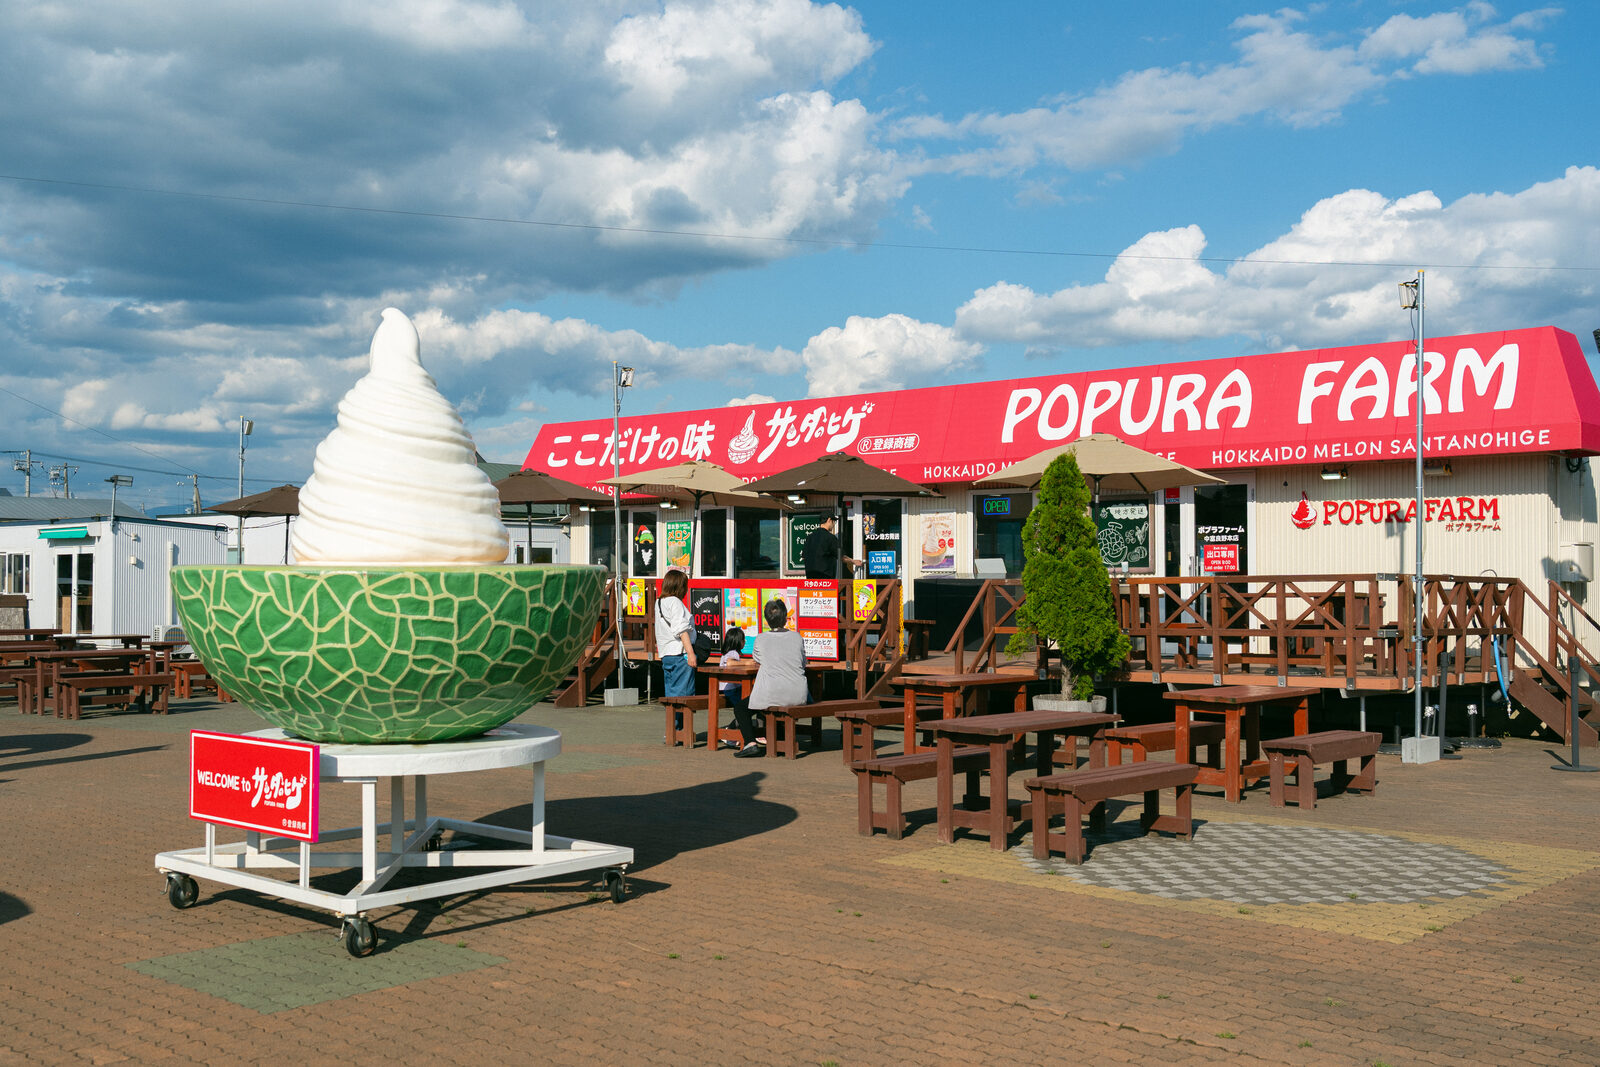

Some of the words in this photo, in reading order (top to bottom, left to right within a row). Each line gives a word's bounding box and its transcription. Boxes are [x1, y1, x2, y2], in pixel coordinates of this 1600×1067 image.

[1001, 368, 1252, 443] POPURA
[1297, 343, 1520, 425] FARM
[547, 420, 715, 467] ここだけの味
[1212, 446, 1306, 464] HOKKAIDO
[1314, 440, 1382, 458] MELON
[1390, 429, 1551, 454] SANTANOHIGE
[923, 463, 996, 479] HOKKAIDO
[985, 500, 1009, 513] OPEN
[1323, 499, 1417, 525] POPURA
[1424, 496, 1500, 522] FARM
[1445, 522, 1501, 532] ポプラファーム
[668, 530, 690, 540] メロン
[1206, 550, 1235, 558] 出口専用
[694, 614, 720, 626] OPEN
[855, 610, 872, 618] OU
[197, 769, 240, 791] WELCOME
[241, 777, 251, 792] to
